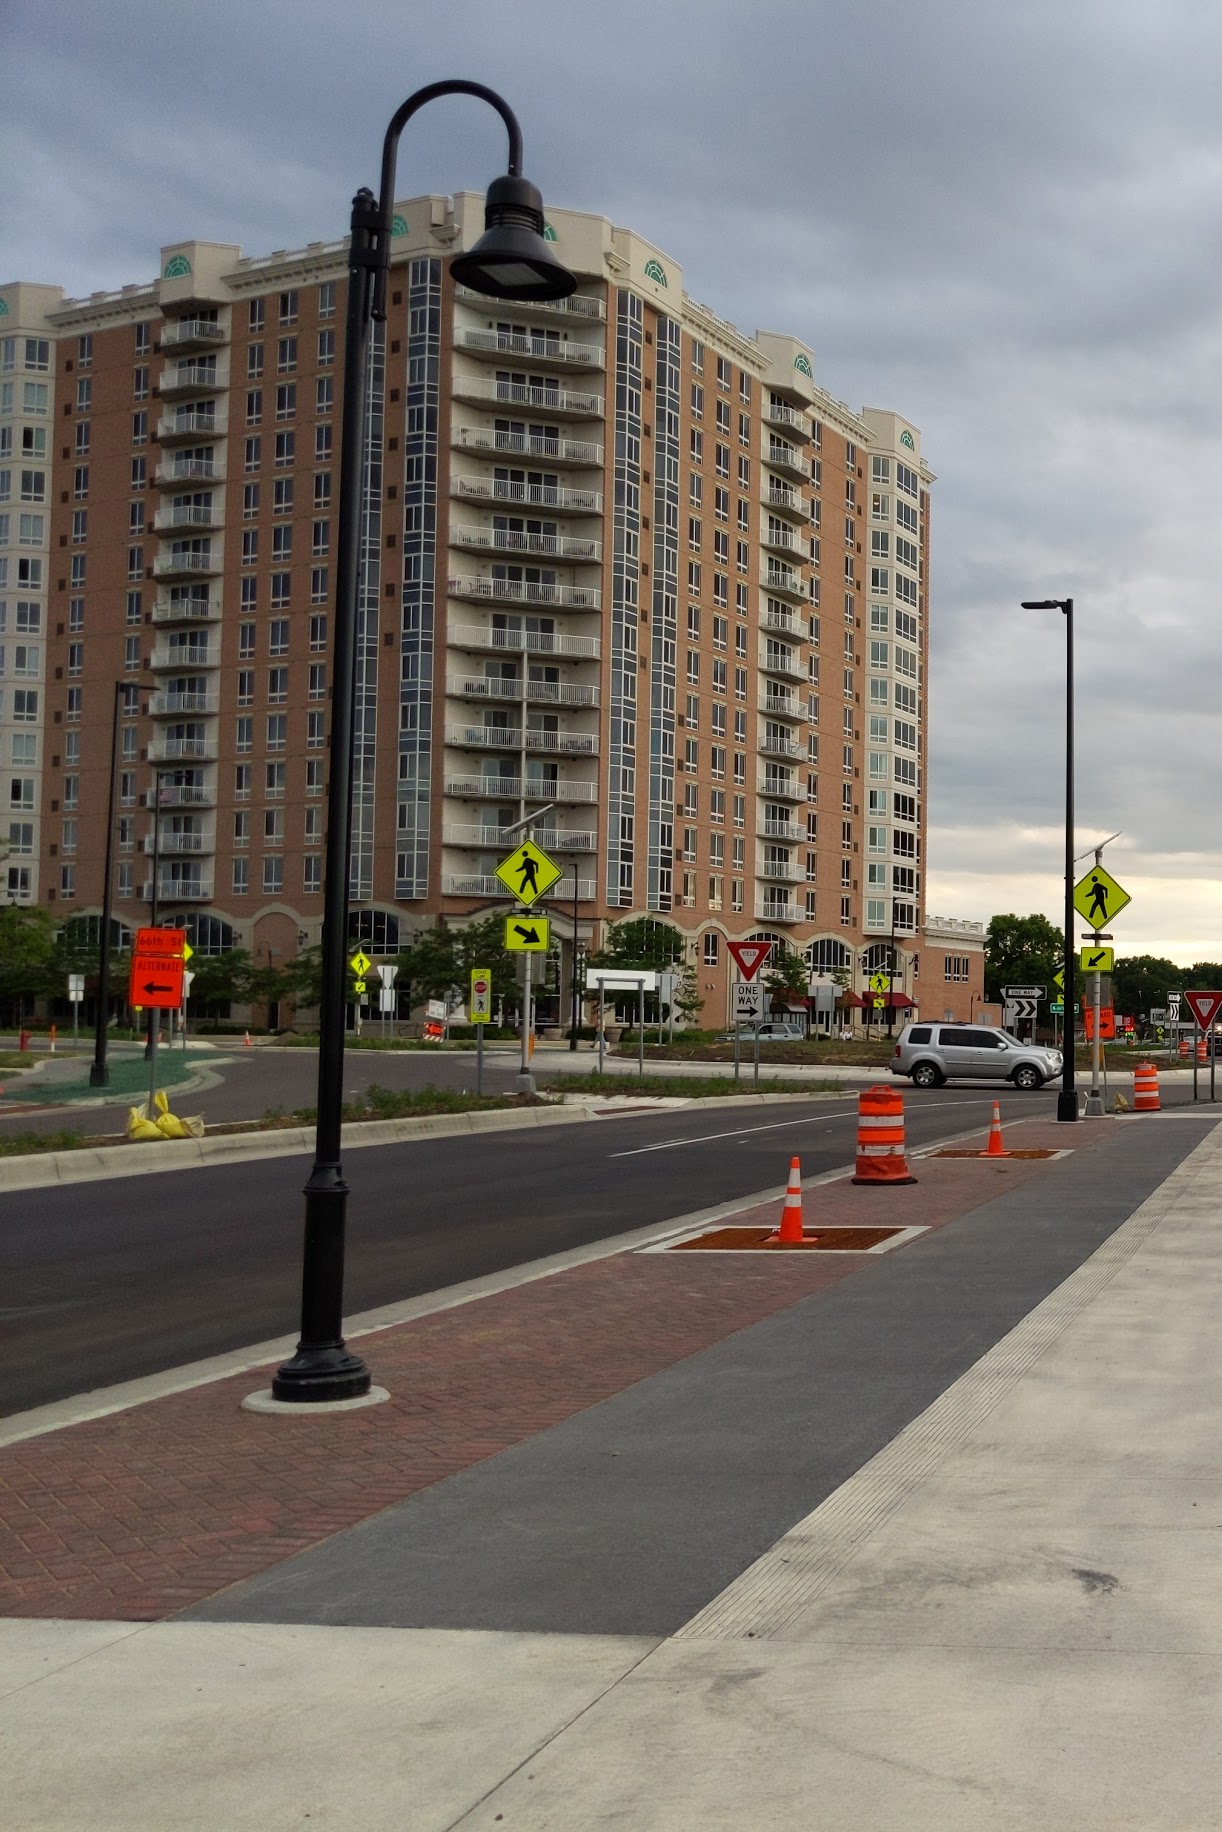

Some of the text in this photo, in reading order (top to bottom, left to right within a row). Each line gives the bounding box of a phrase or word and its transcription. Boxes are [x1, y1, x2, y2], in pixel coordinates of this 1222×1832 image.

[139, 937, 183, 946] 66th St
[137, 961, 180, 972] ALTERNATE
[738, 986, 758, 995] ONE
[738, 996, 759, 1005] WAY
